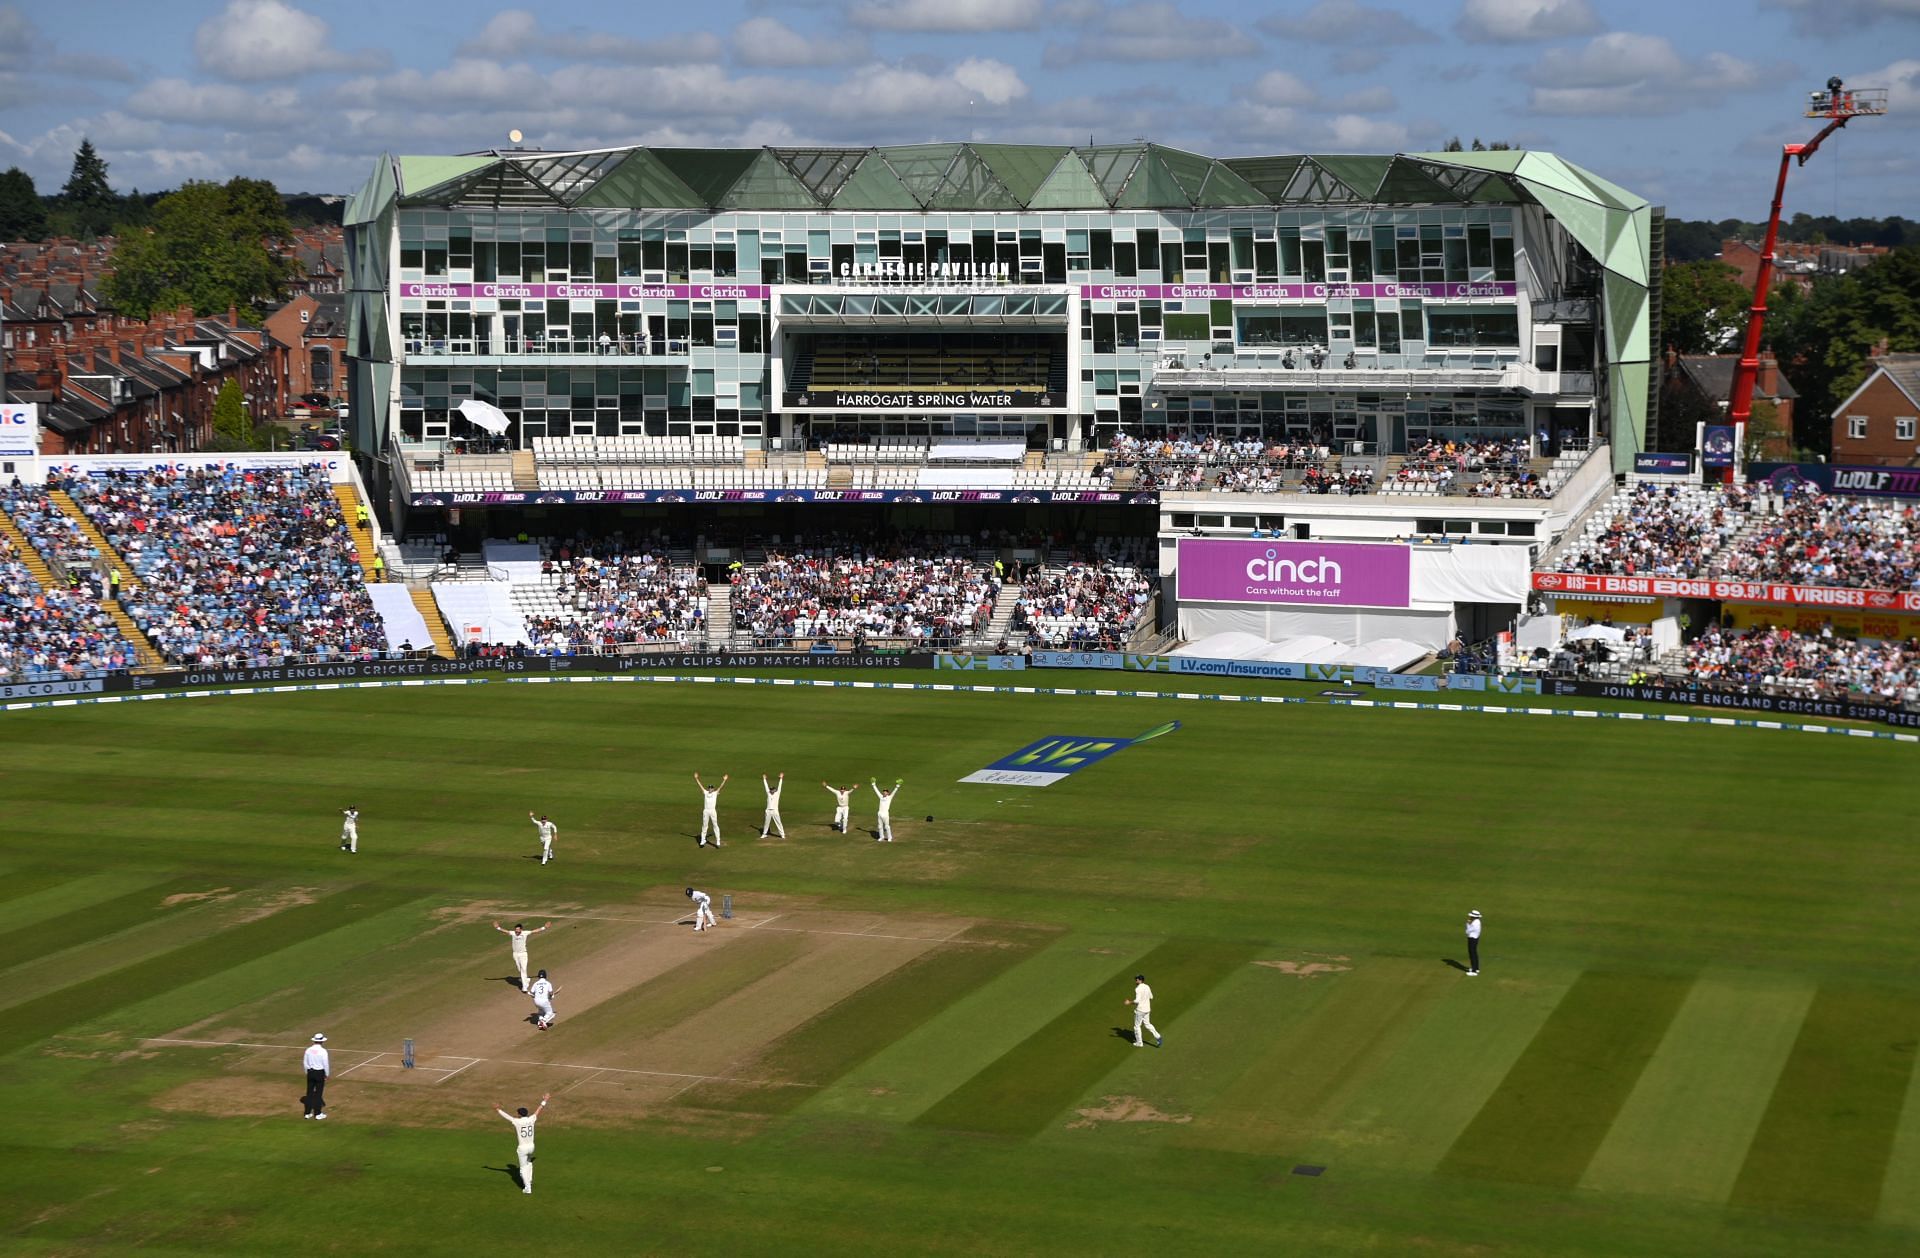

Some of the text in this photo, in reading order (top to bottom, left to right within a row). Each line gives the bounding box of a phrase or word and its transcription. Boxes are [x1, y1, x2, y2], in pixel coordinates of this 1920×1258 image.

[840, 262, 1010, 276] CARNEGIE PAVILION
[409, 285, 458, 297] Clarion
[483, 285, 531, 297] Clarion
[556, 285, 603, 297] Clarion
[629, 286, 675, 297] Clarion
[700, 286, 747, 297] Clarion
[1100, 287, 1146, 298] Clarion
[1171, 286, 1217, 297] Clarion
[1242, 285, 1288, 297] Clarion
[1385, 285, 1432, 296] Clarion
[1456, 285, 1504, 296] Clarion
[837, 395, 1012, 406] HARROGATE SPRING WATER
[1246, 548, 1341, 584] cinch
[1246, 586, 1341, 597] Cars without the faff
[1567, 576, 1600, 591] BISH
[1605, 578, 1649, 593] BASH
[1653, 580, 1710, 596] BOSH
[1773, 587, 1789, 600] OF
[1792, 588, 1865, 606] VIRUSES
[619, 656, 900, 669] IN-PLAY CLIPS AND MATCH HIGHLIGHTS
[1180, 659, 1292, 676] LV.com/insurance
[182, 673, 217, 684] JOIN
[223, 671, 245, 681] WE
[251, 669, 280, 680] ARE
[287, 666, 356, 678] ENGLAND
[363, 664, 425, 675] CRICKET
[1601, 686, 1635, 698] JOIN
[1641, 689, 1663, 700] WE
[1669, 690, 1697, 703] ARE
[1703, 693, 1772, 710] ENGLAND
[1778, 699, 1842, 715] CRICKET
[538, 985, 544, 994] 3
[520, 1125, 533, 1138] 58
